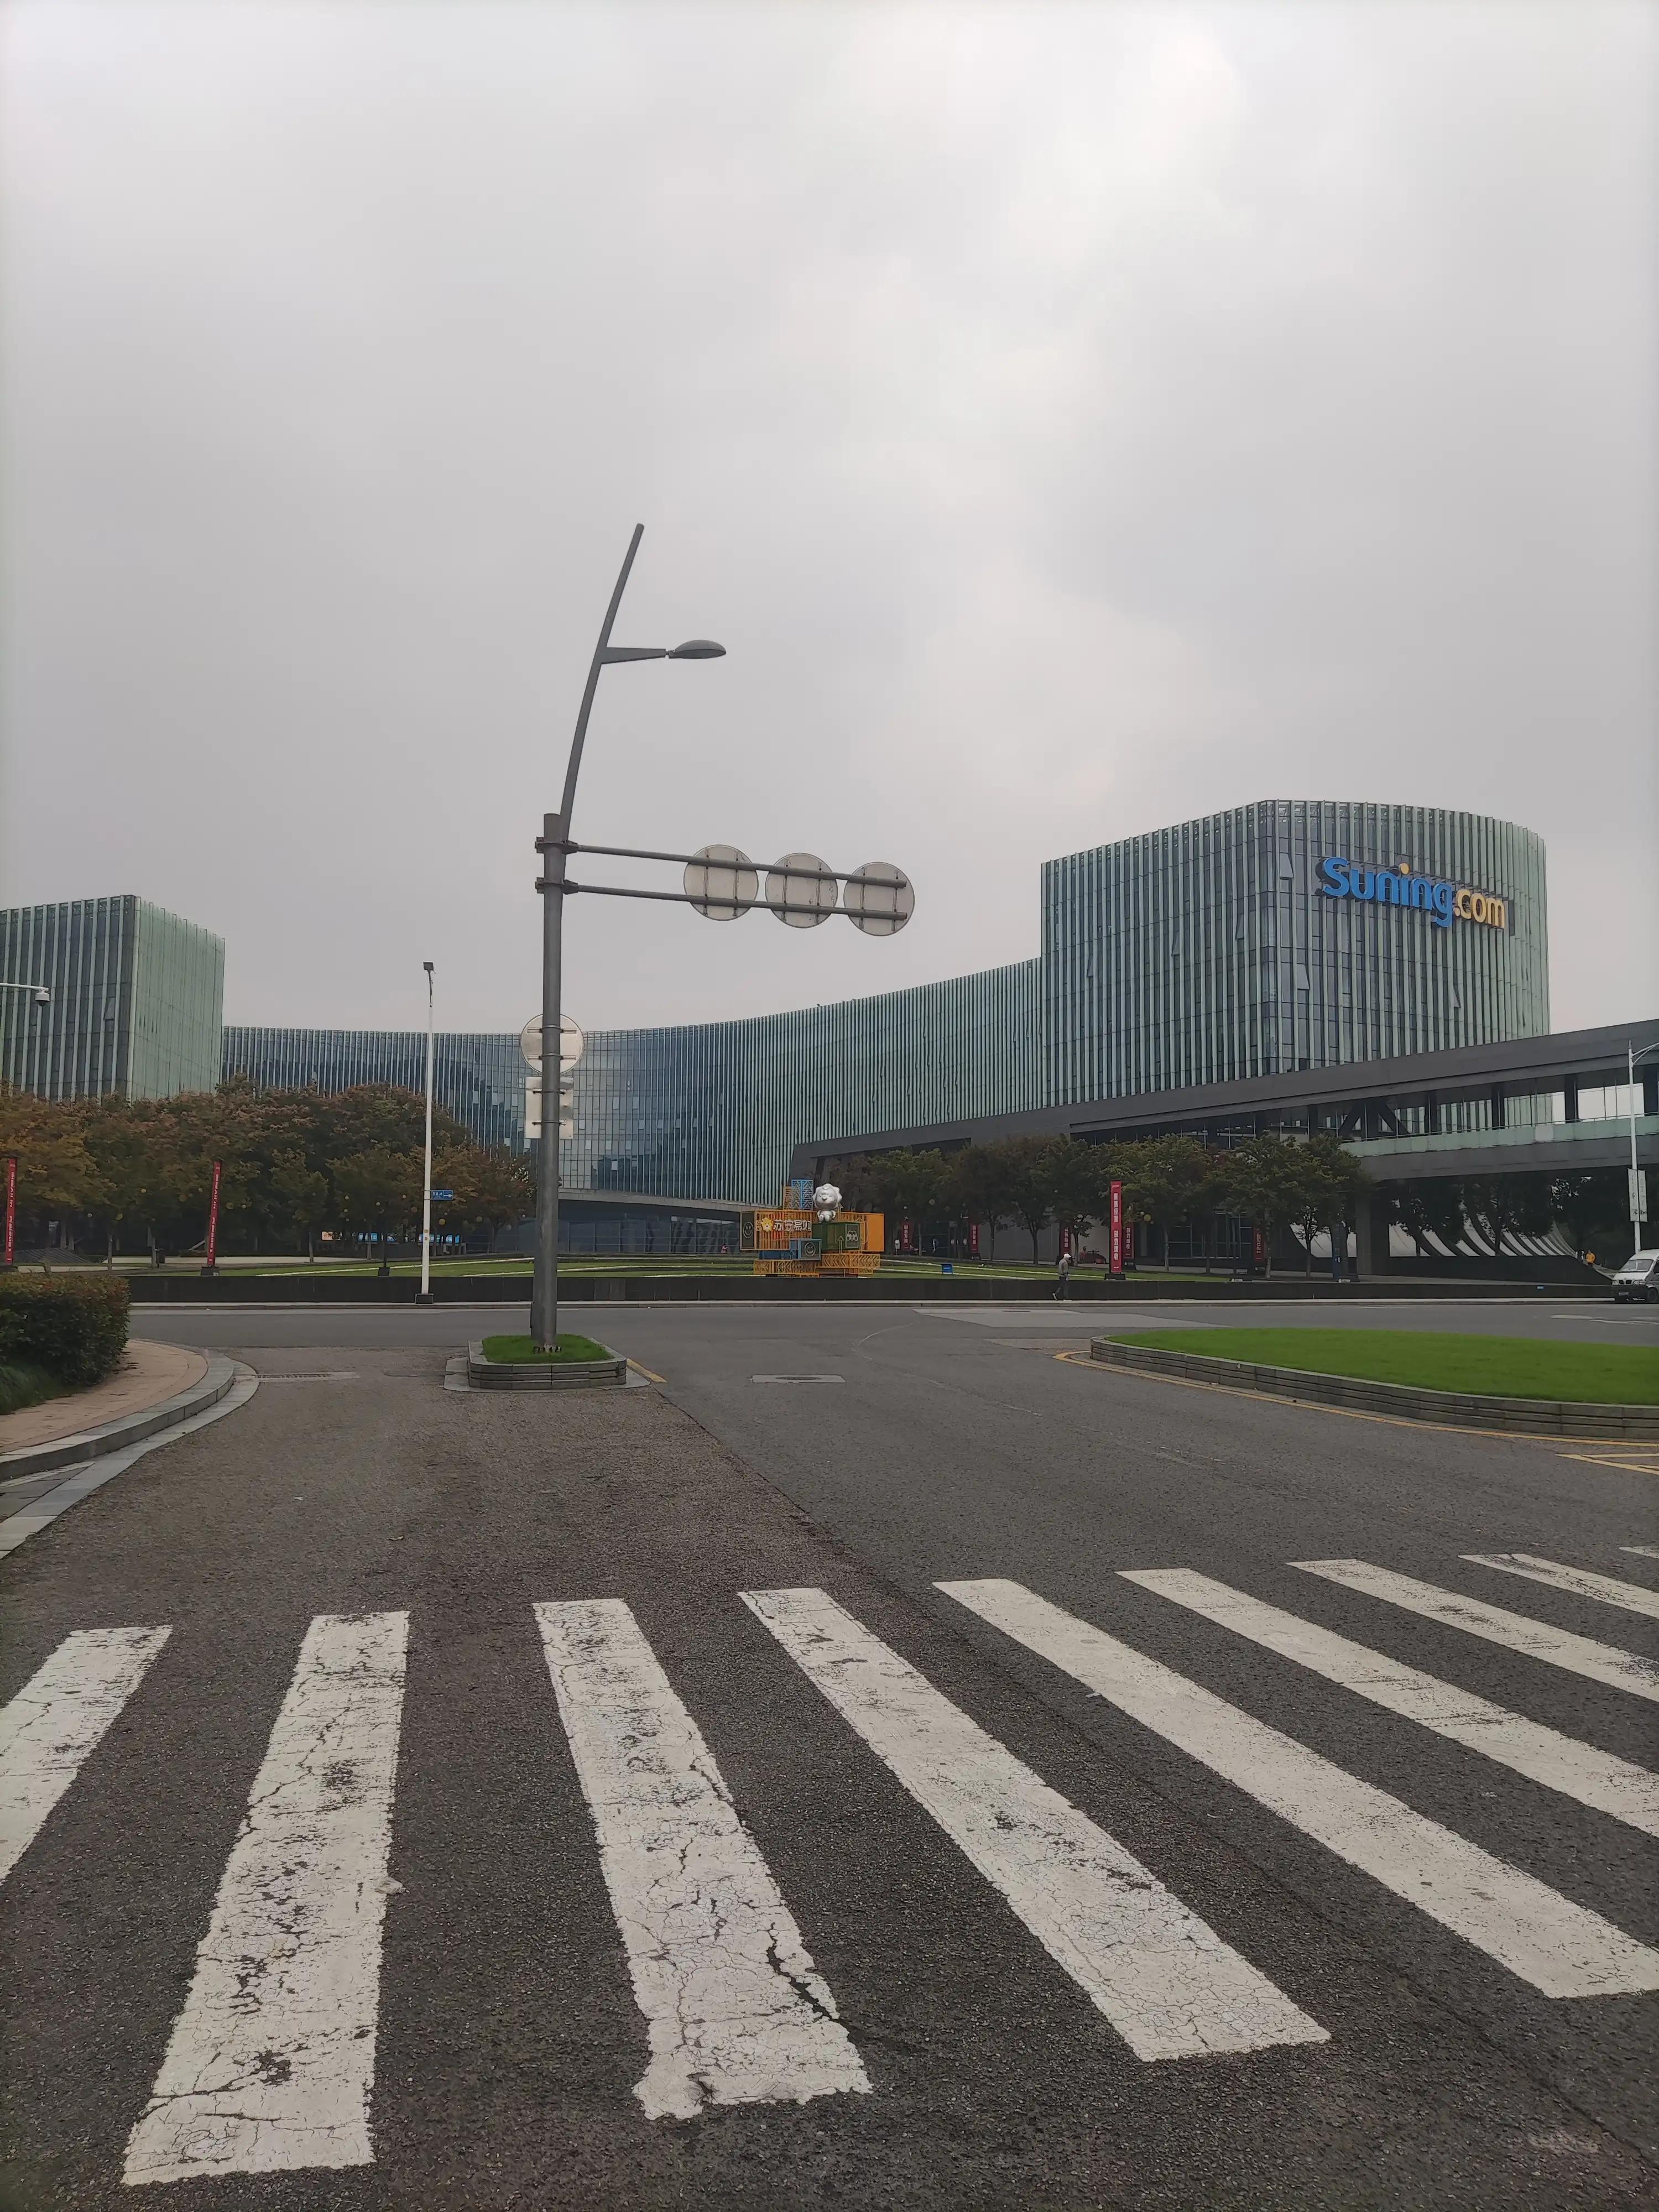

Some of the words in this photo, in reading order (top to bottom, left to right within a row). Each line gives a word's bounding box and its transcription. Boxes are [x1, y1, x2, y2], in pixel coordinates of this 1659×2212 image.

[1322, 857, 1505, 929] Suning.com
[773, 1219, 812, 1232] 苏宁易购
